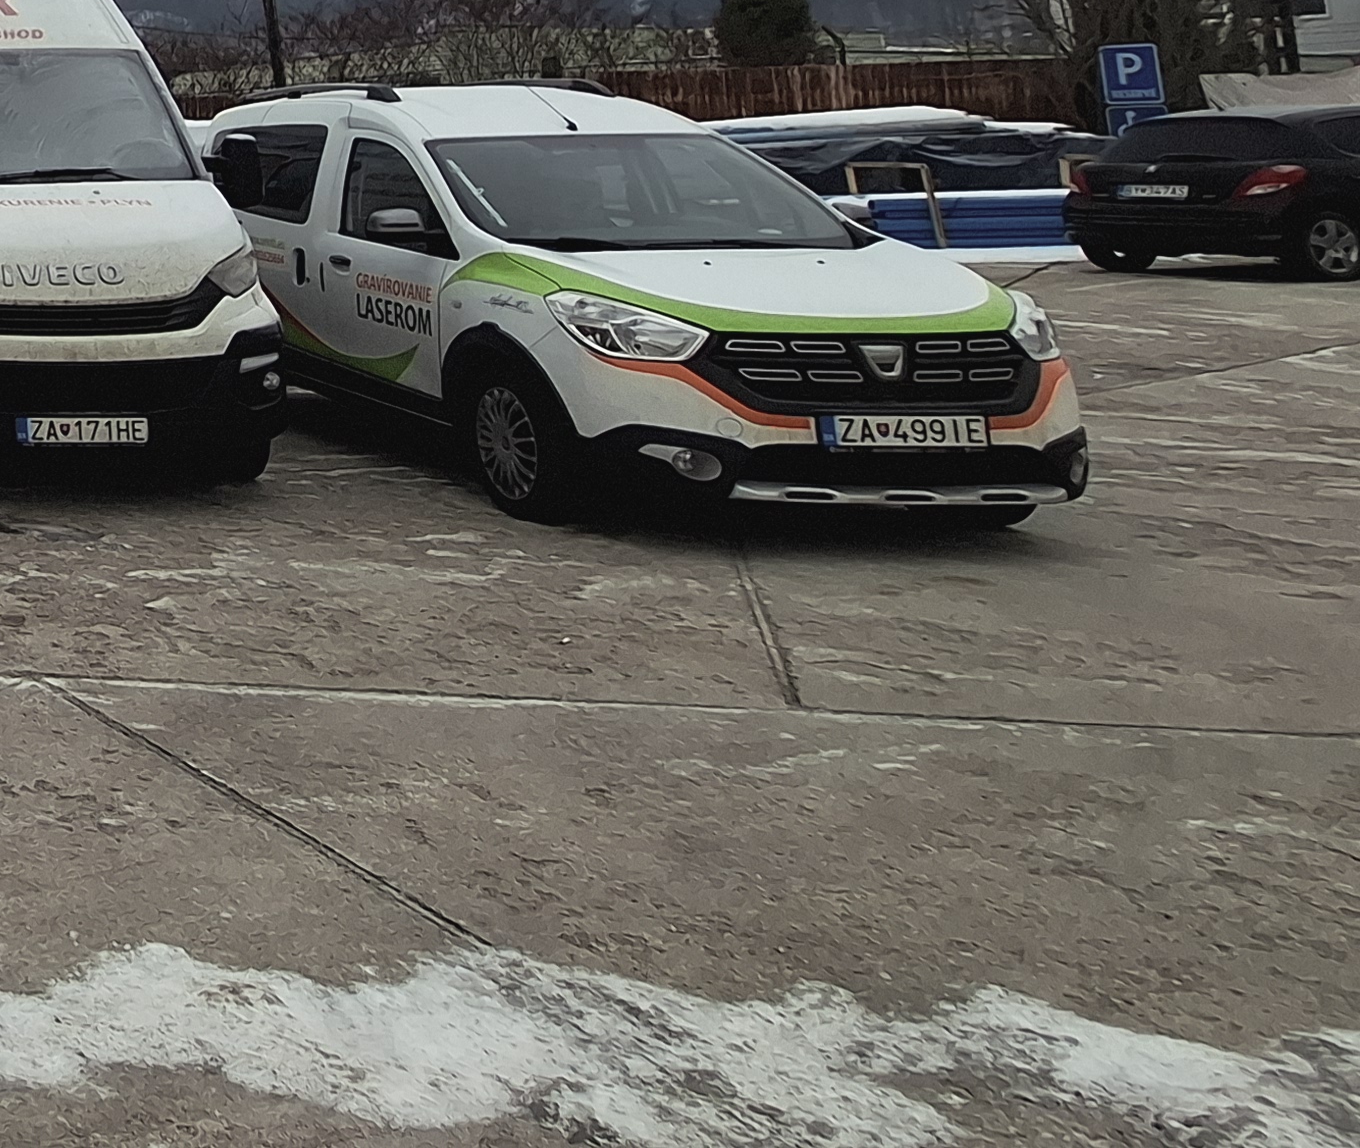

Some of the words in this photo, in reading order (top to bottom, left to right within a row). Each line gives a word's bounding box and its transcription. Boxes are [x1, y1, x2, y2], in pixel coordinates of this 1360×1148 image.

[1115, 53, 1142, 85] P
[1, 263, 125, 288] IVECO
[355, 293, 432, 337] LASEROM
